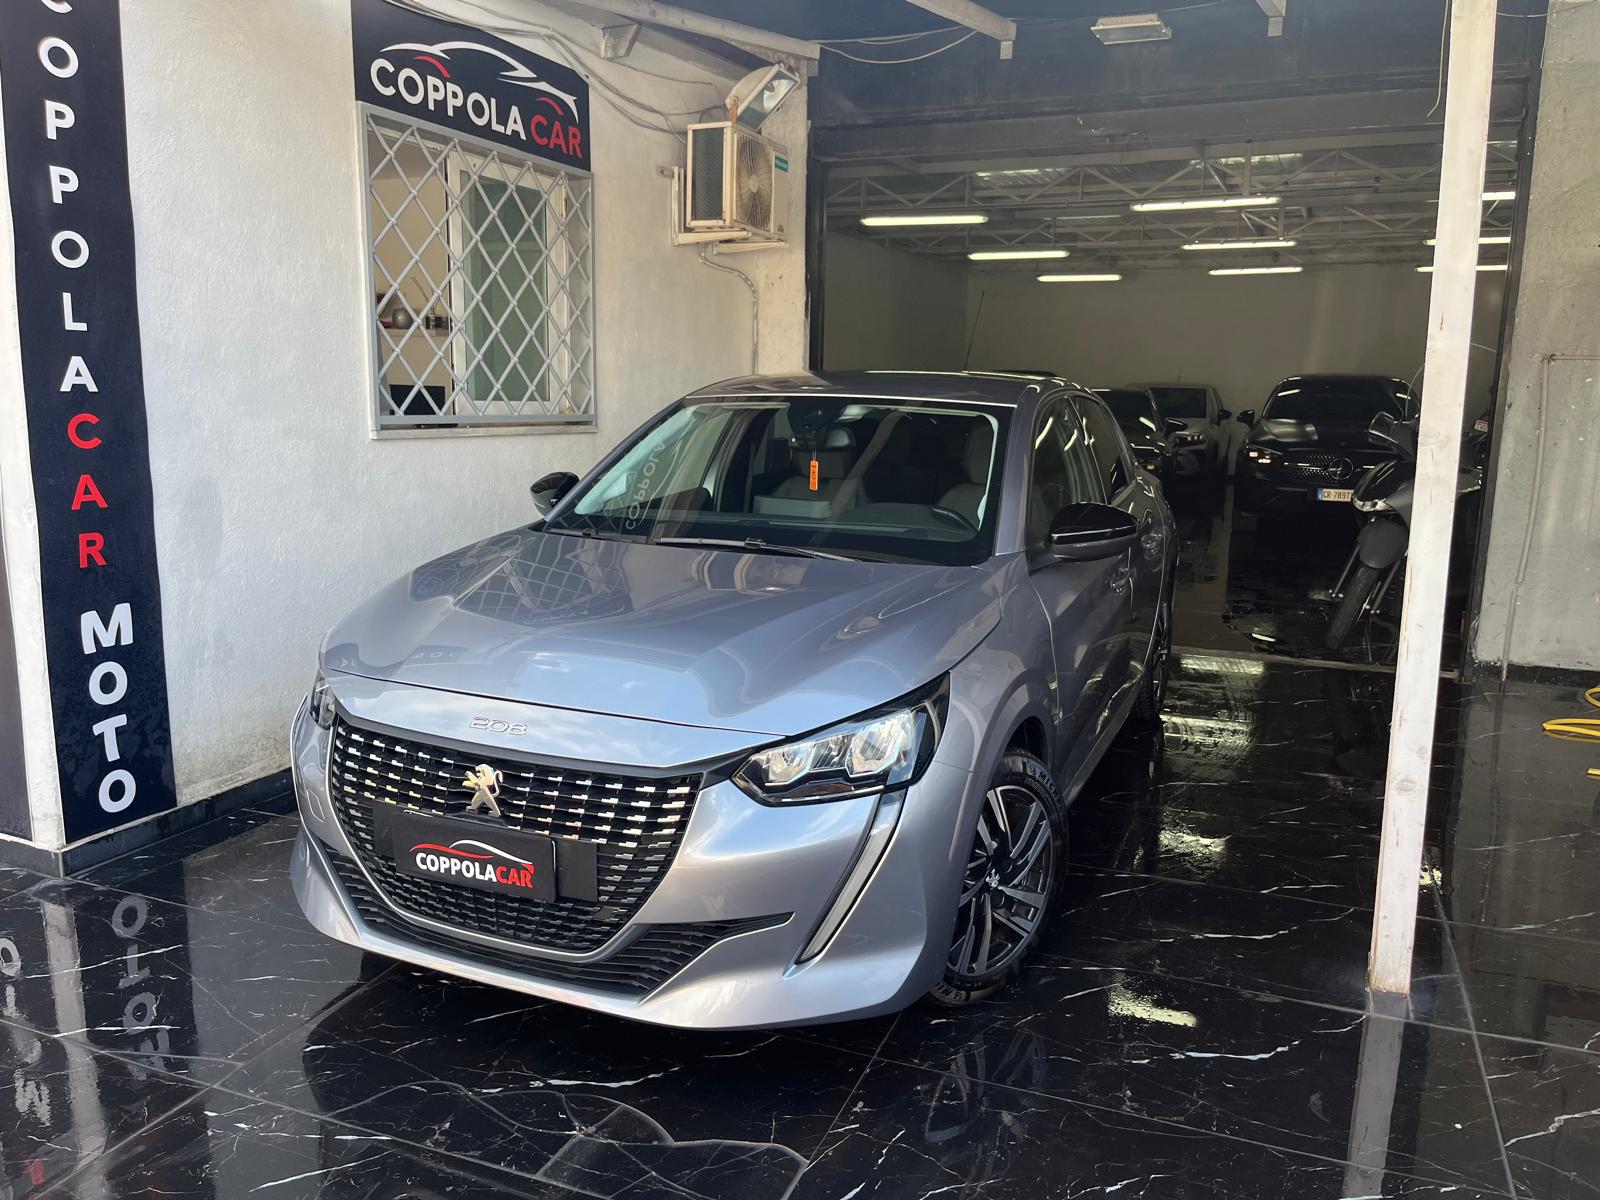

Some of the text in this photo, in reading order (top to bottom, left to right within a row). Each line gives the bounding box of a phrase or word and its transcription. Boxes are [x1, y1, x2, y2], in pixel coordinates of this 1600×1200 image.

[370, 58, 583, 158] COPPOLA CAR
[80, 602, 137, 813] MOTO
[470, 716, 528, 736] 208
